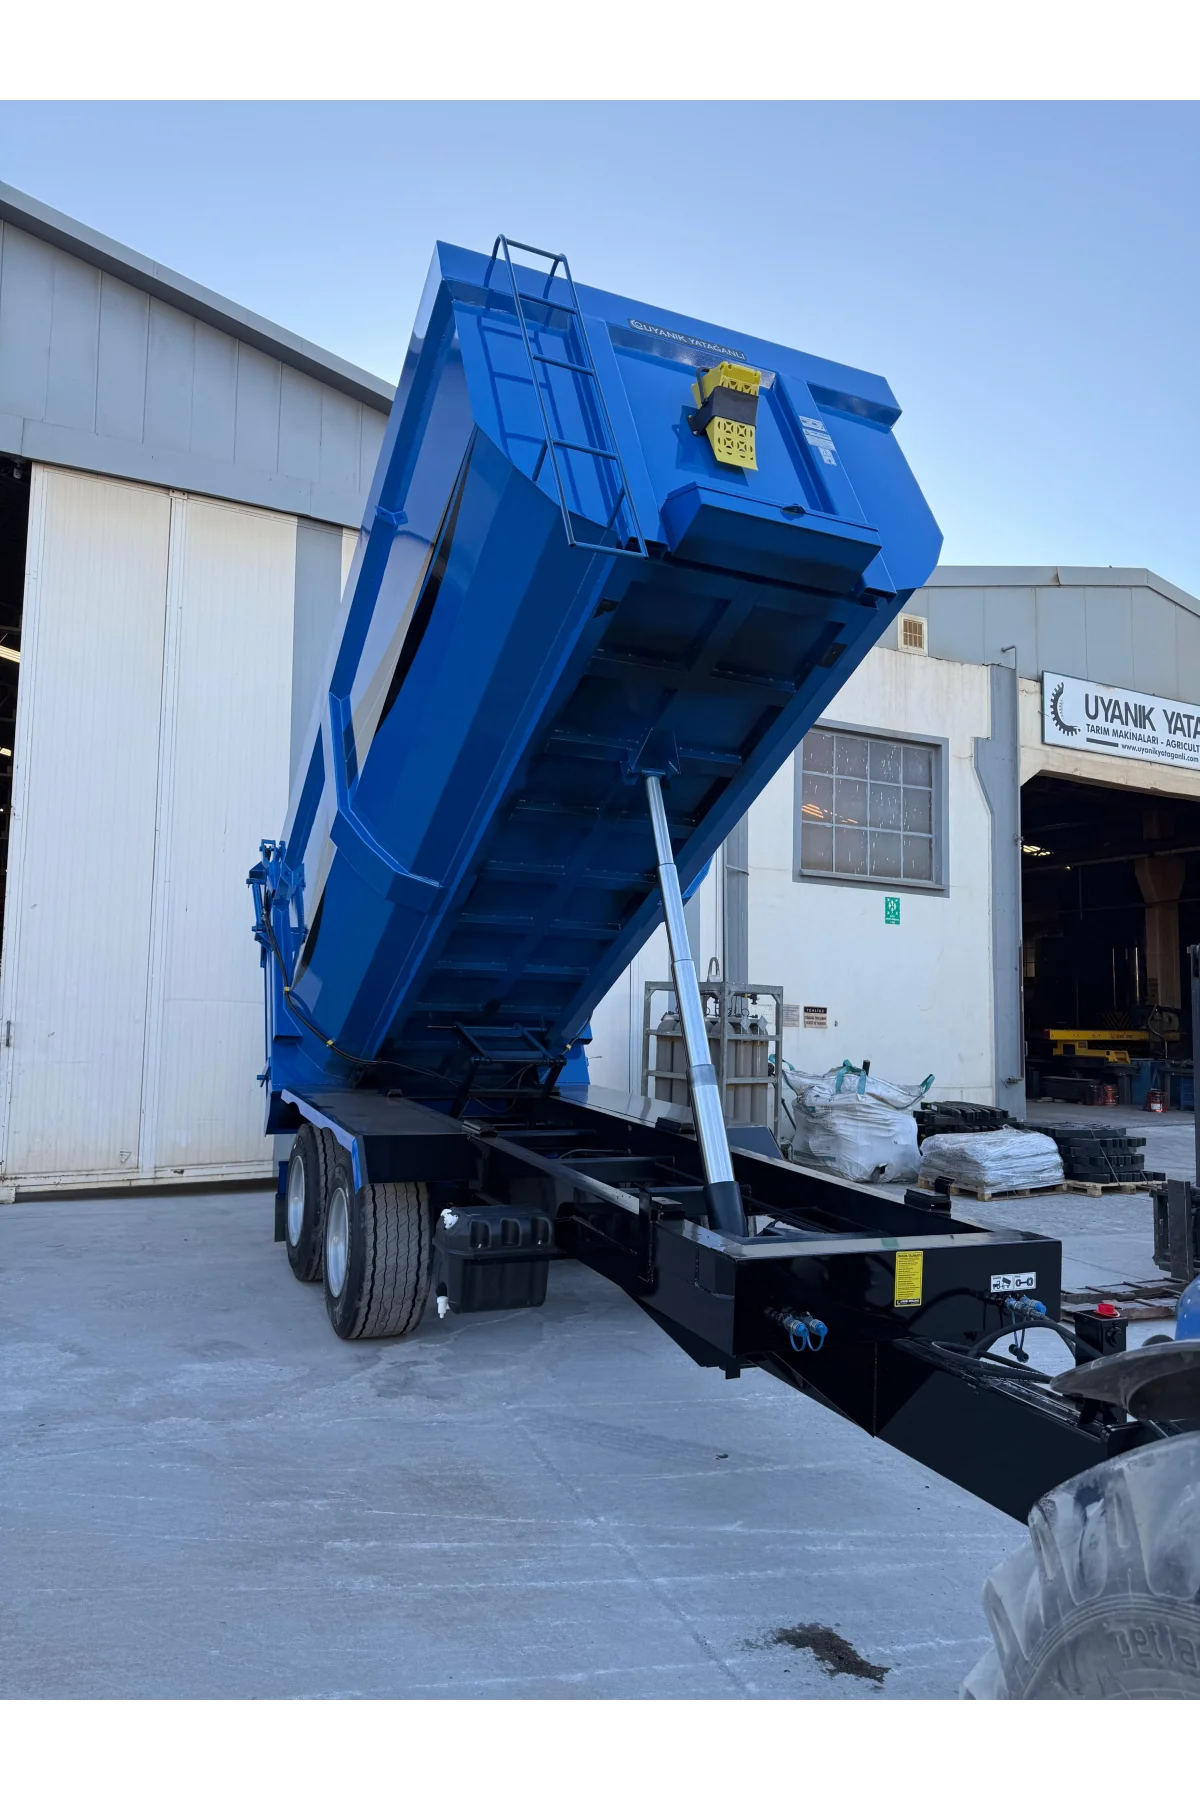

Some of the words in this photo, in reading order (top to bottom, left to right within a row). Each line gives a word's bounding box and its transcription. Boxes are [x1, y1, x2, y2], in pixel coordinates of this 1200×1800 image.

[643, 325, 687, 343] UYANIK
[1085, 693, 1156, 731] UYANIK
[1086, 723, 1110, 737] TARIM
[1112, 728, 1159, 746] MAKİNALARI
[1121, 744, 1199, 762] www.uyanikyataganli.com
